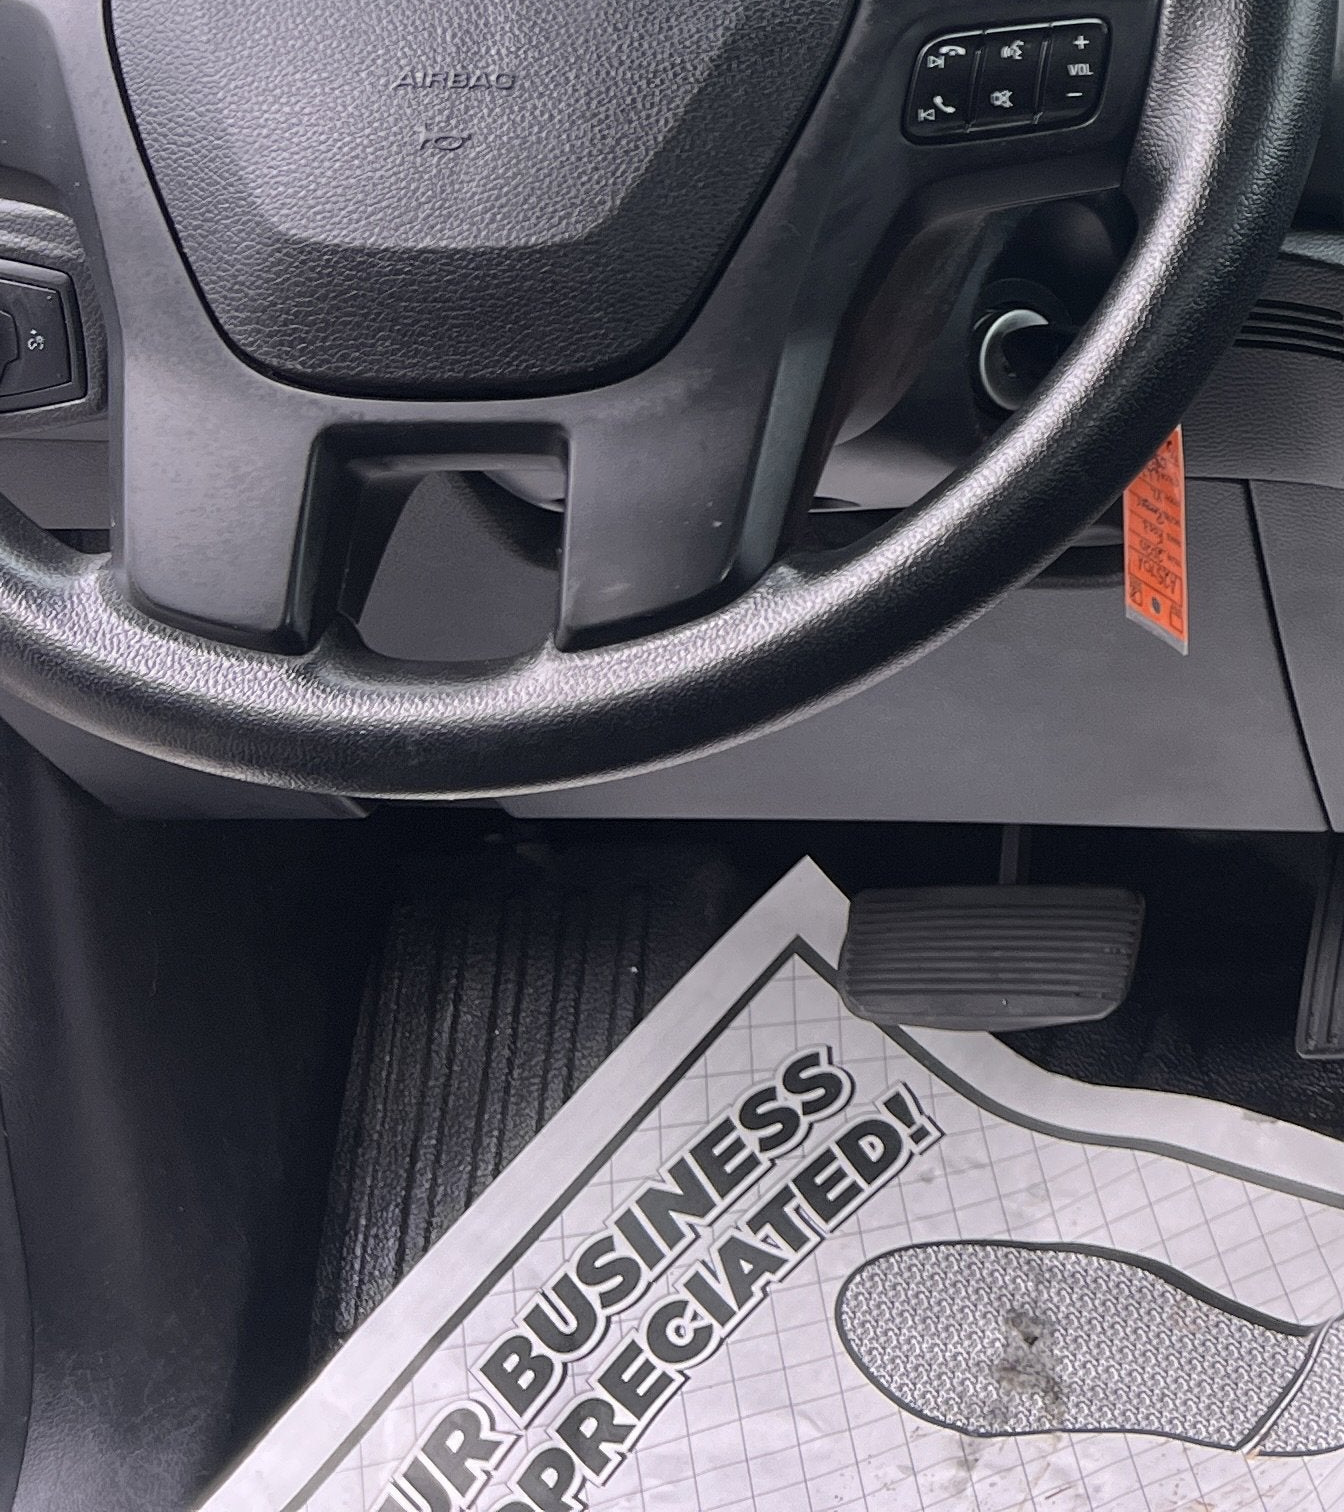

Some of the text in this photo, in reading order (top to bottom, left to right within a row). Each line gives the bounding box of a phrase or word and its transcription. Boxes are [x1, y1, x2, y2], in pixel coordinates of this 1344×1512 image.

[390, 68, 517, 91] AIRBAG
[1066, 63, 1094, 76] VOL
[476, 1048, 847, 1422] BUSINESS
